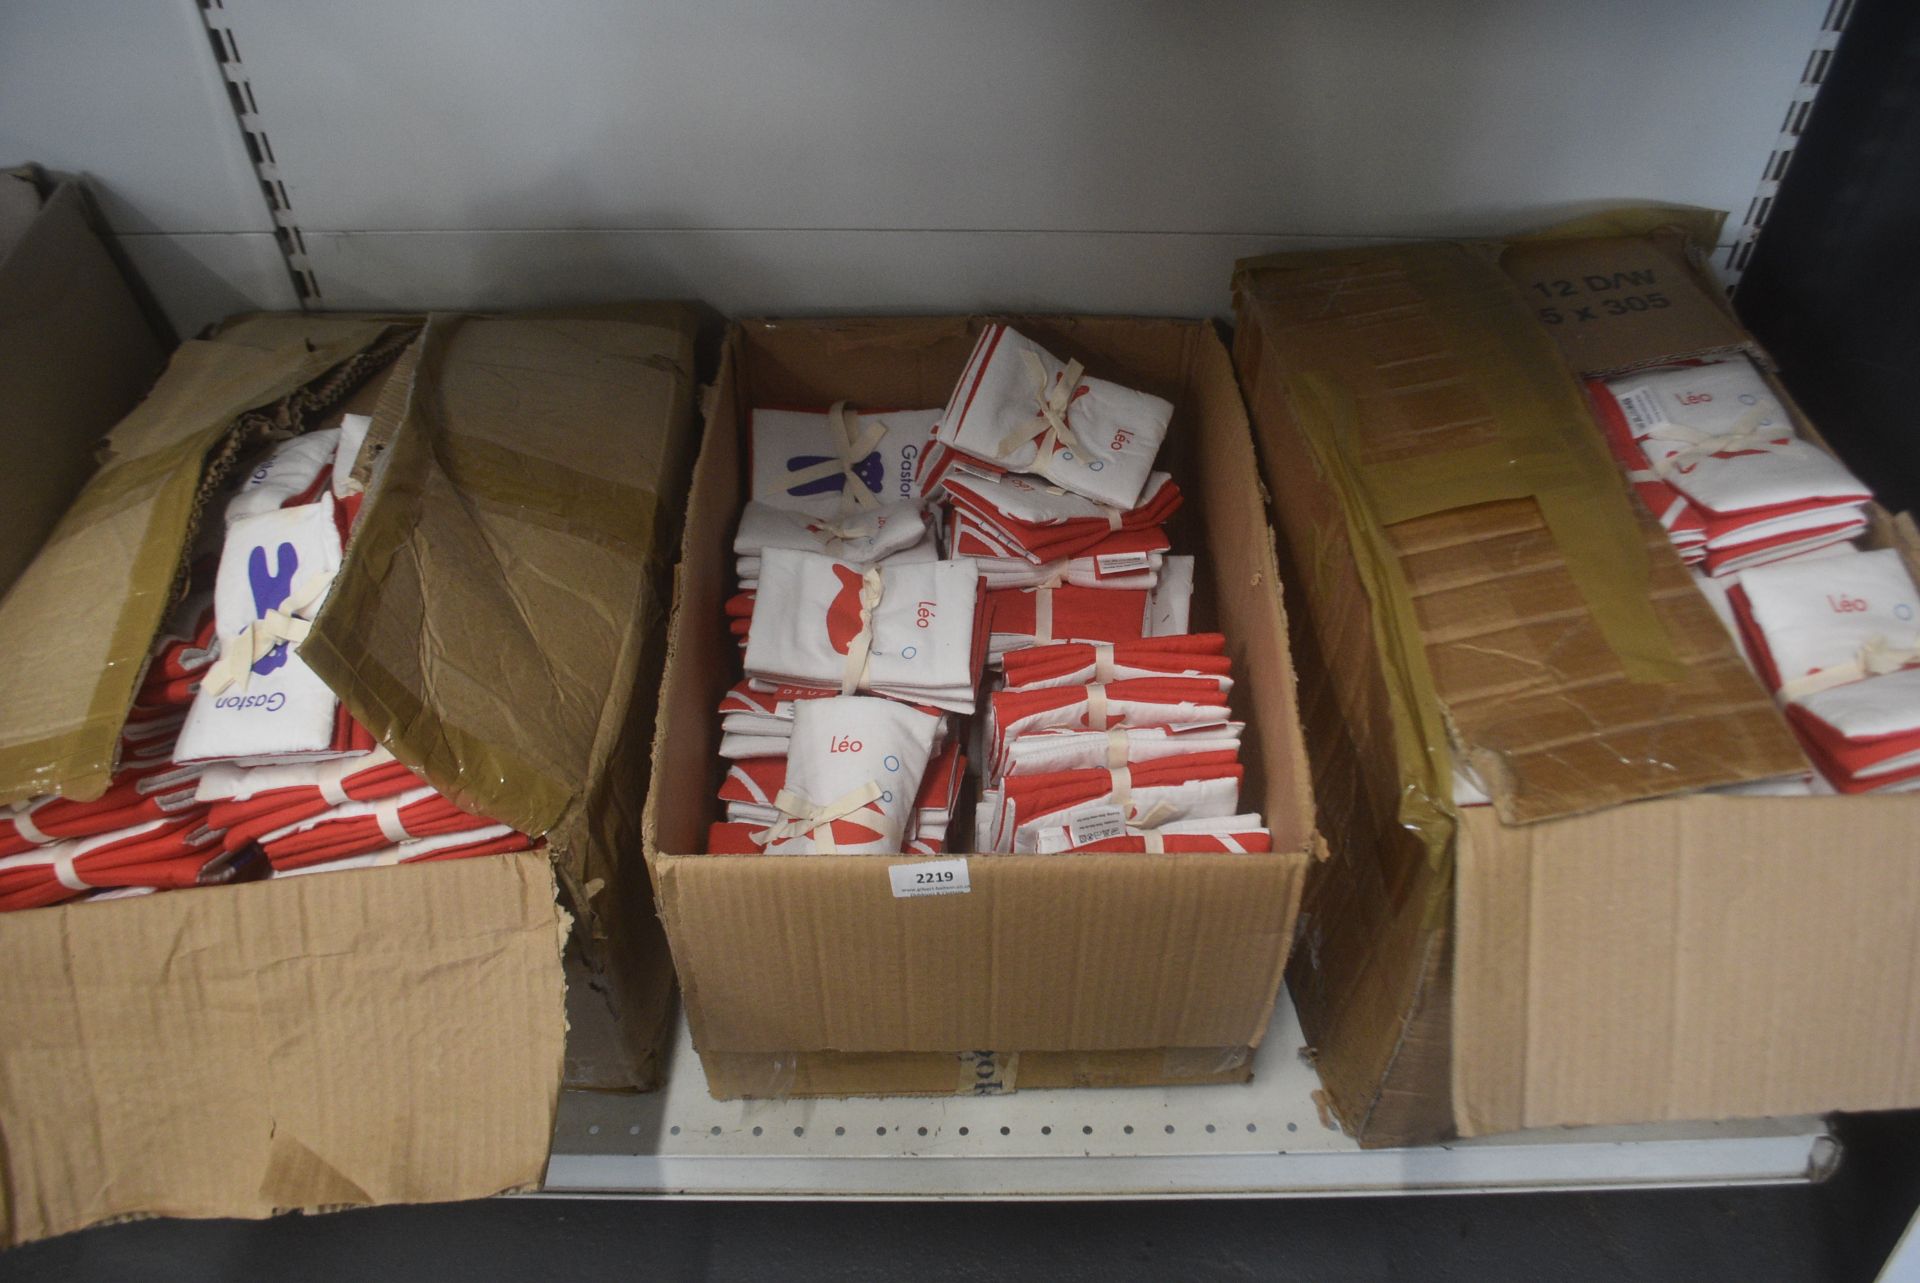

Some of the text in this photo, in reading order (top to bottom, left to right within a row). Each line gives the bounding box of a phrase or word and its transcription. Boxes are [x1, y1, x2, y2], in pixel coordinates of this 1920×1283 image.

[1532, 278, 1579, 298] 12
[1536, 307, 1565, 324] 5
[1601, 292, 1671, 316] 305
[1110, 428, 1135, 451] Léo
[1826, 593, 1868, 613] Léo
[916, 601, 937, 628] Léo
[215, 691, 286, 712] Gaston
[830, 734, 863, 753] Léo
[915, 871, 954, 884] 2219
